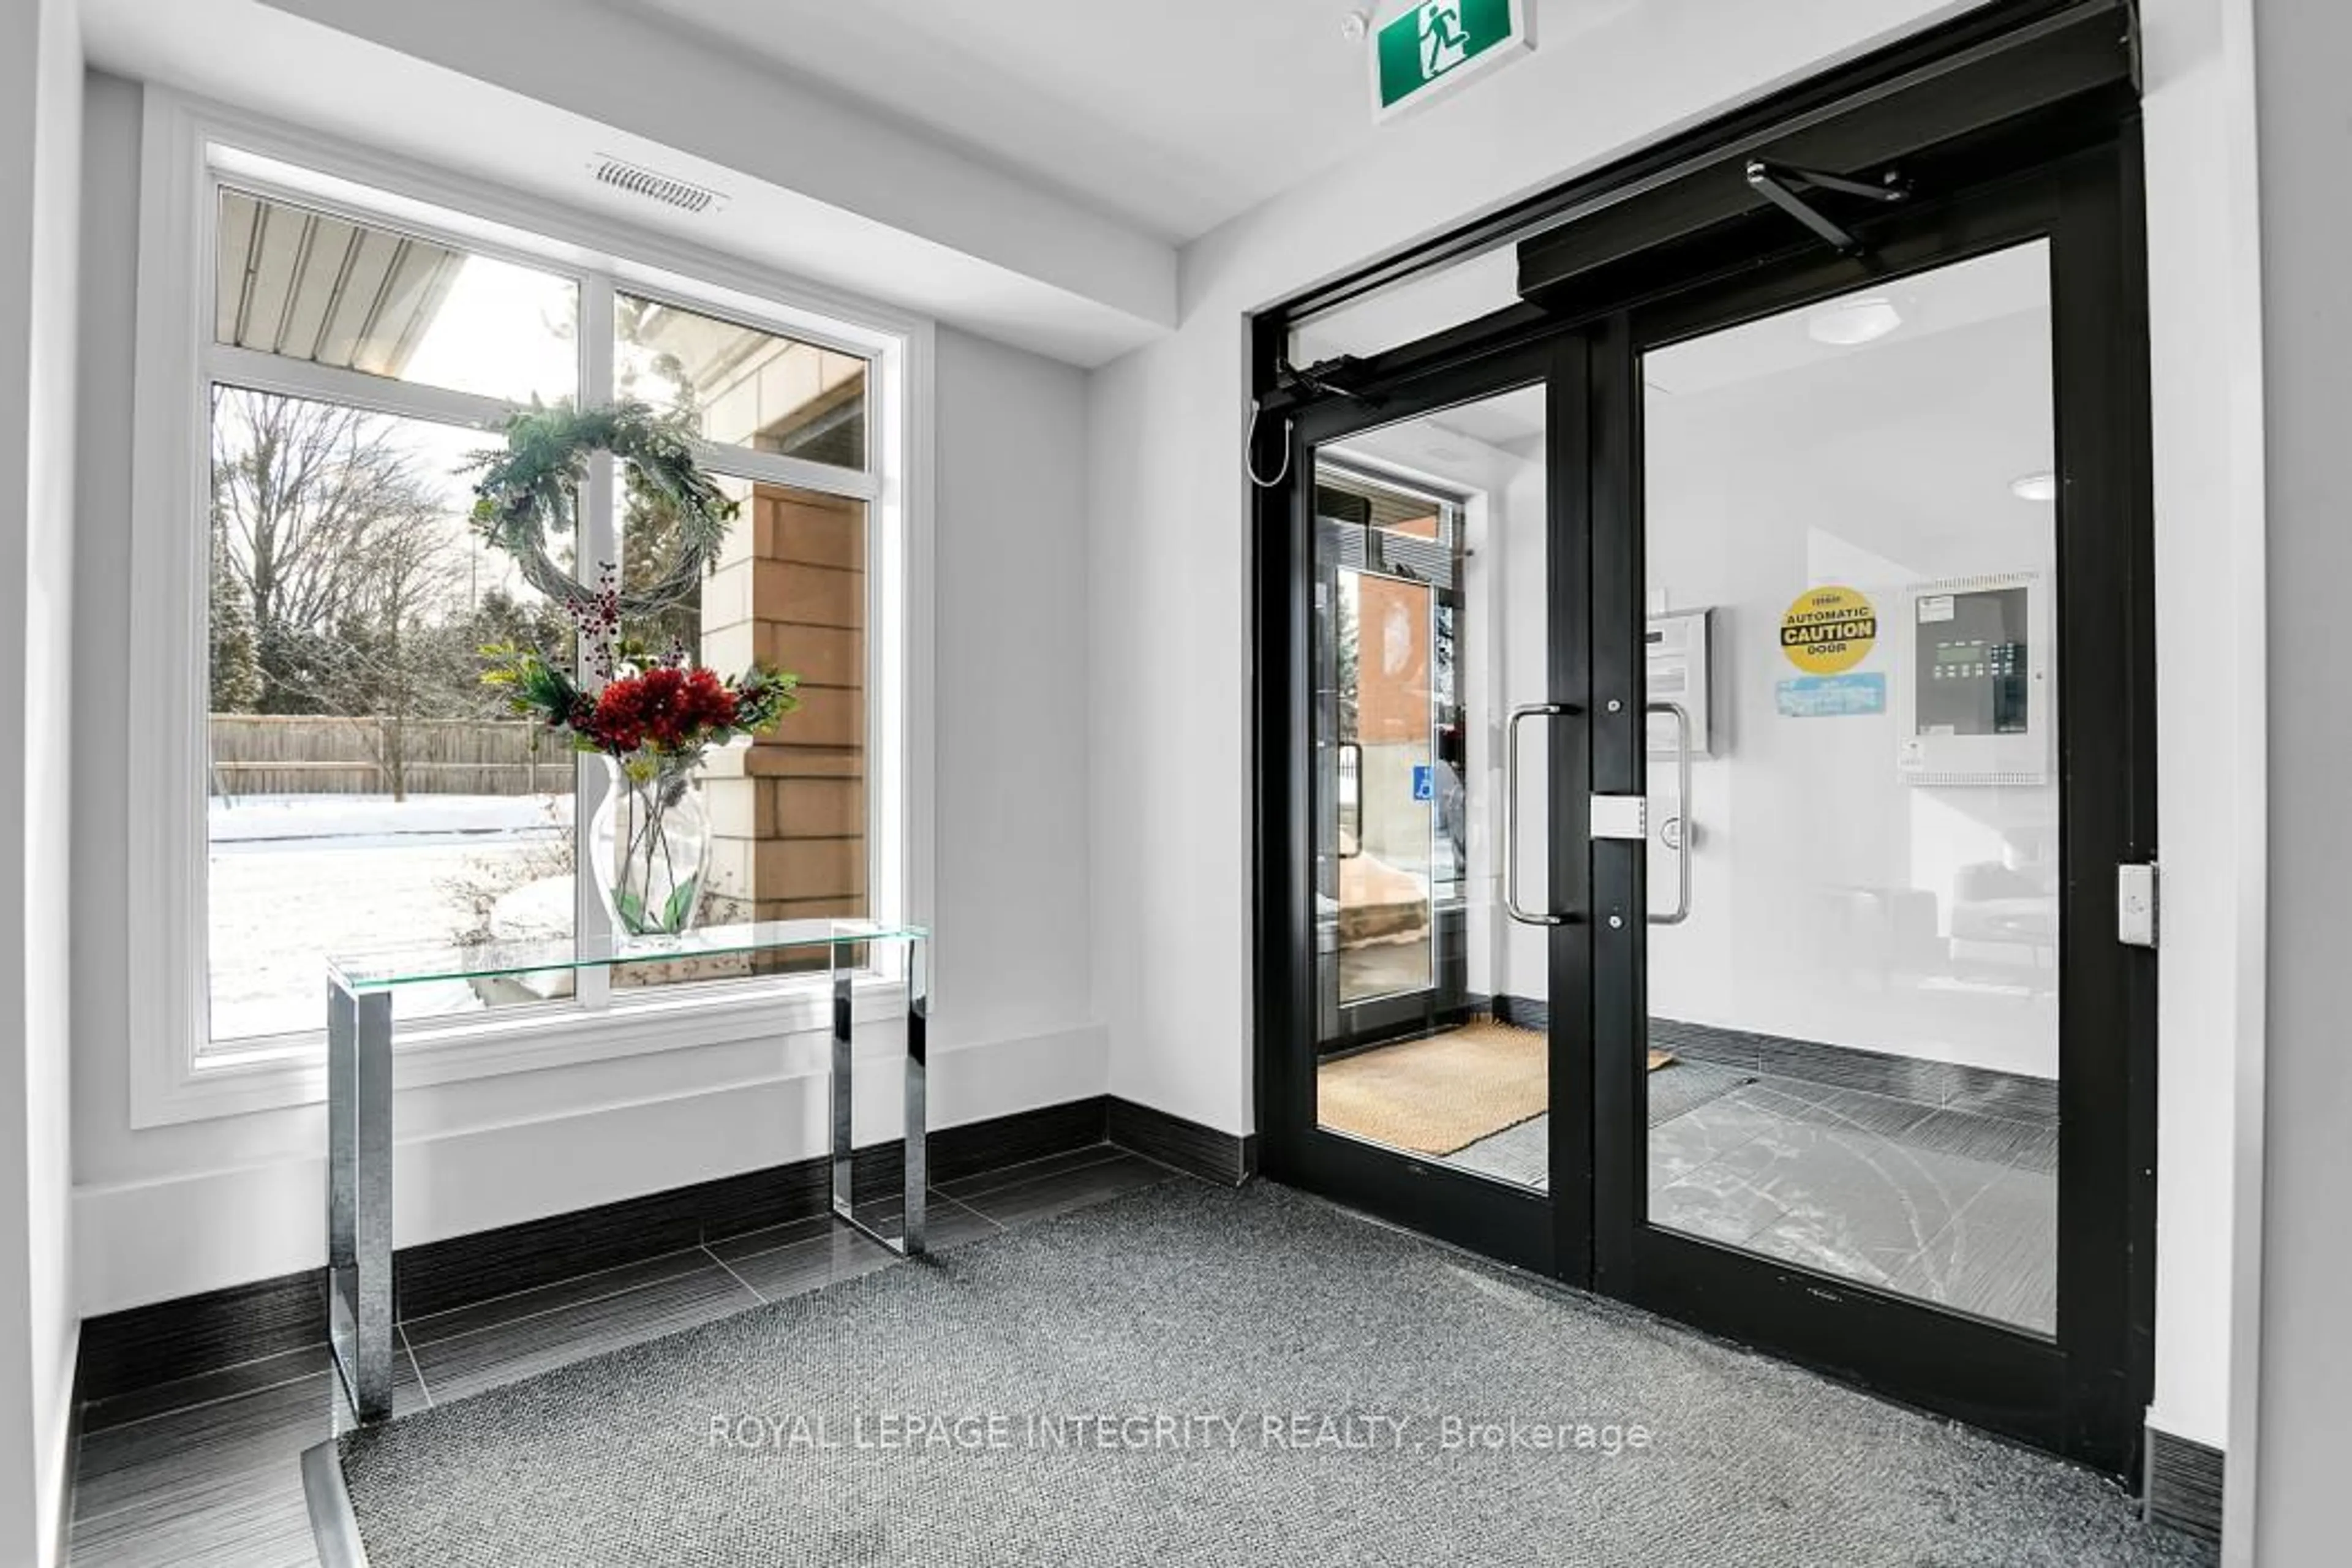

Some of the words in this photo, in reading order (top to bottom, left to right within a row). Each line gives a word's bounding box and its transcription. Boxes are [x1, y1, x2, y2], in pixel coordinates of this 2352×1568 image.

[1787, 606, 1869, 625] AUTOMATIC
[1784, 620, 1873, 644] CAUTION
[1807, 643, 1847, 655] DOOR
